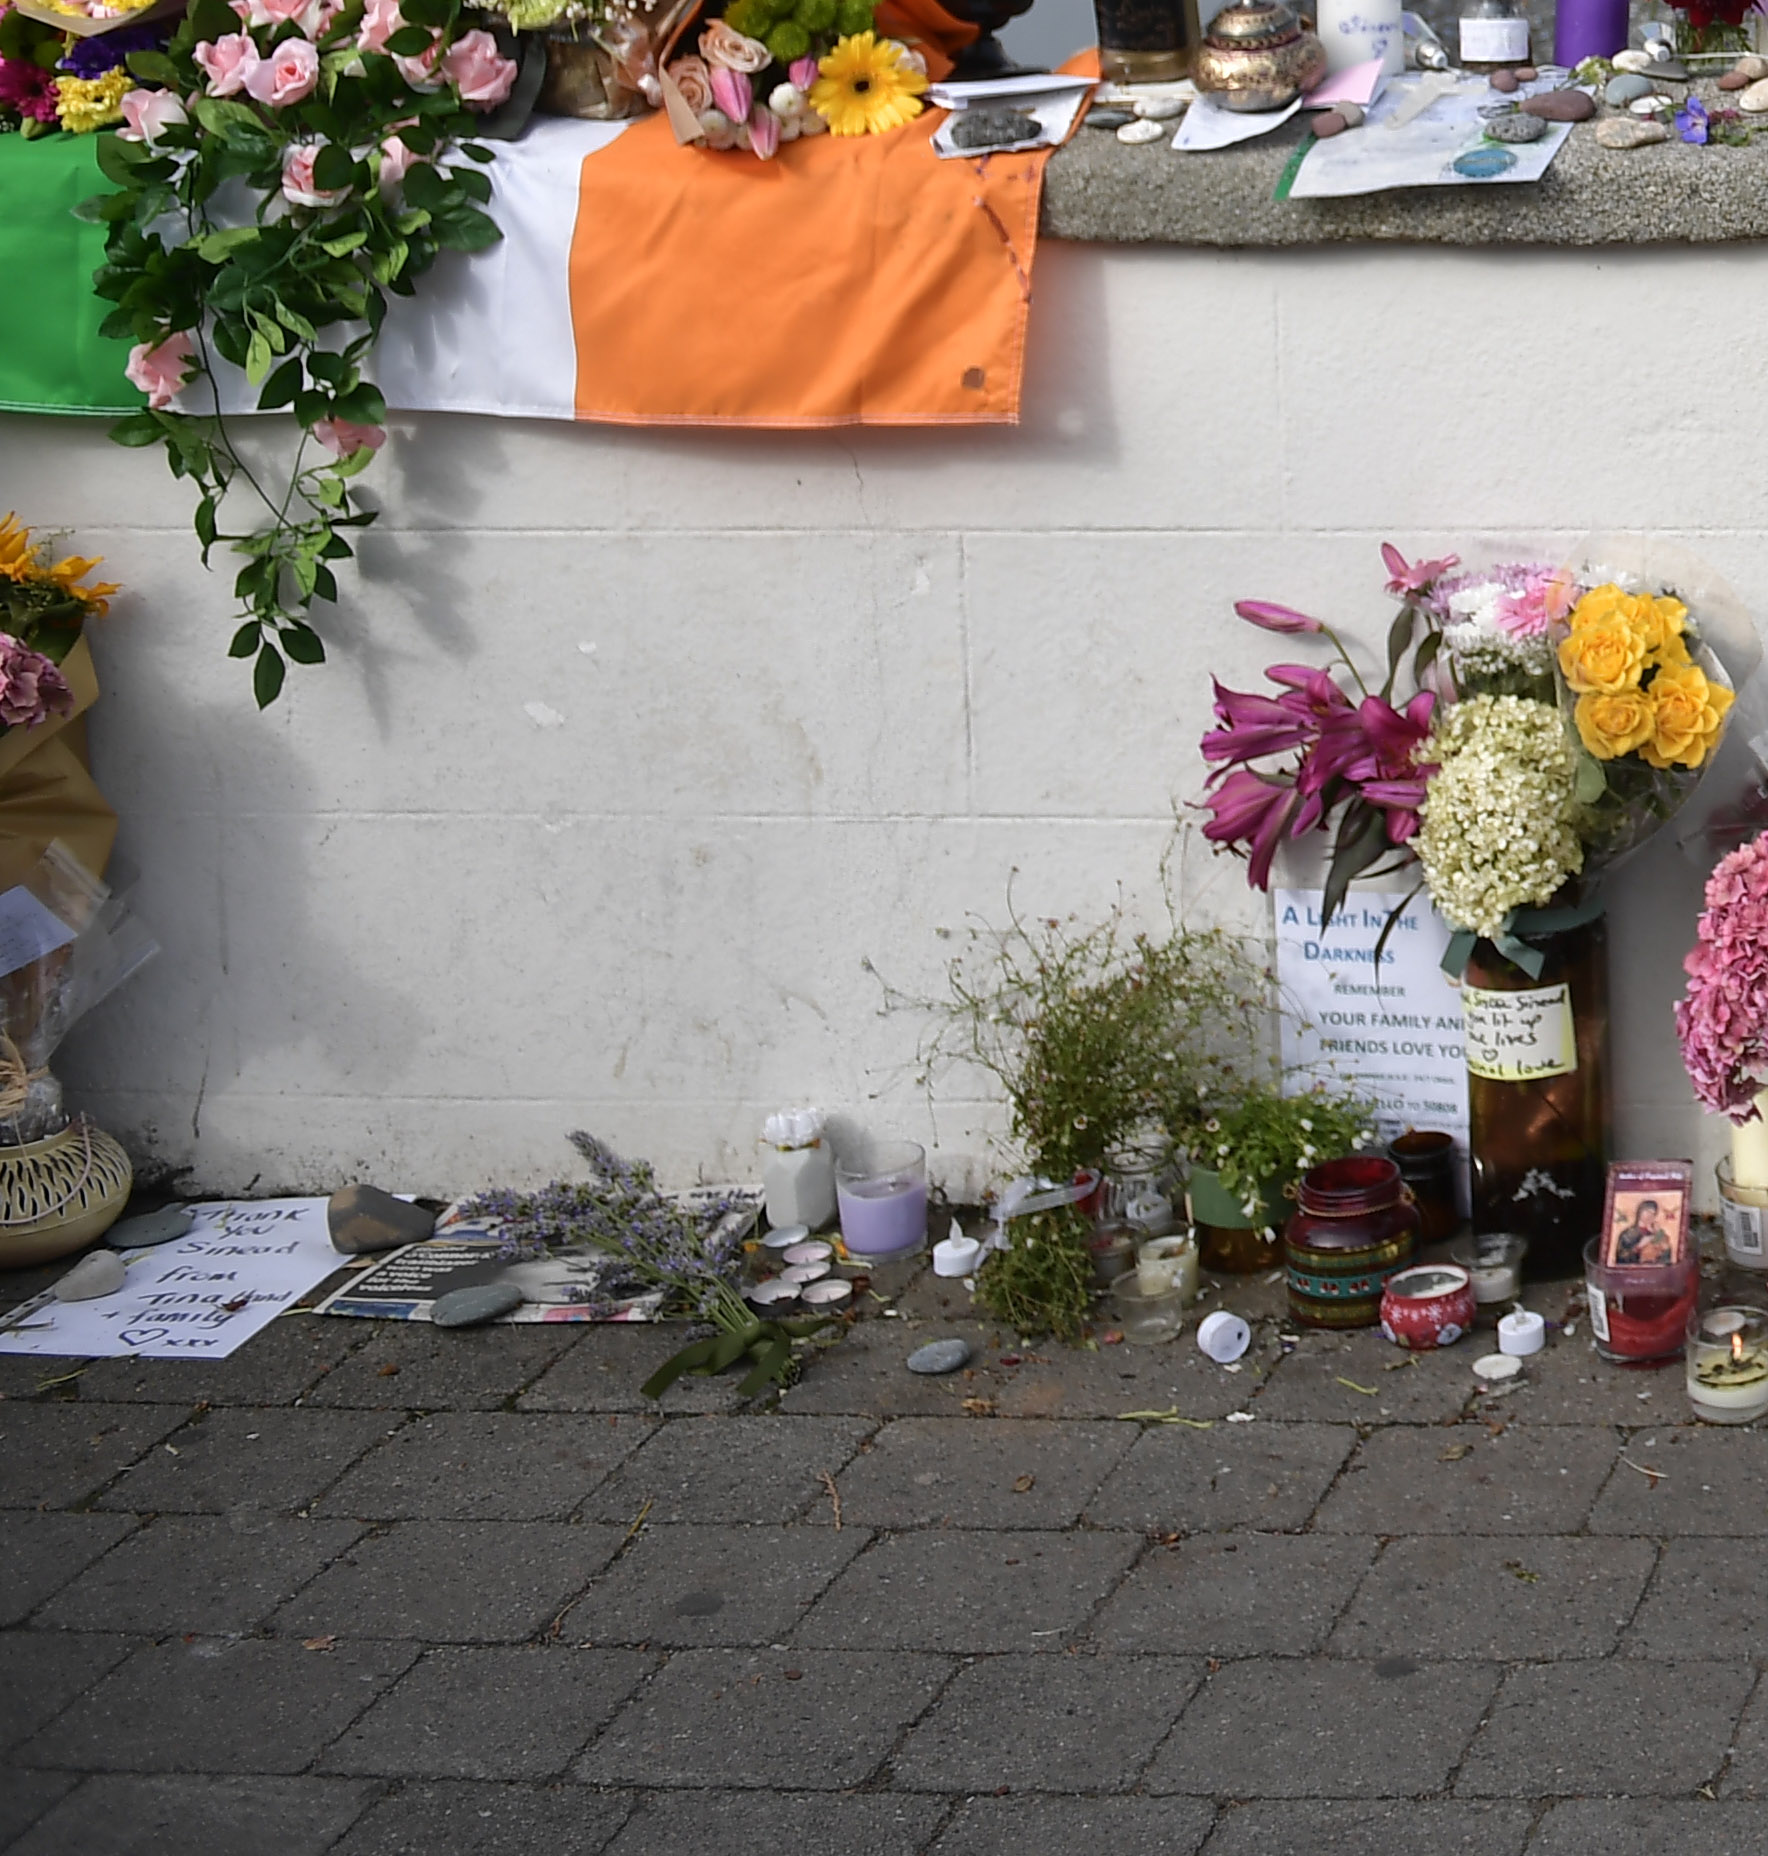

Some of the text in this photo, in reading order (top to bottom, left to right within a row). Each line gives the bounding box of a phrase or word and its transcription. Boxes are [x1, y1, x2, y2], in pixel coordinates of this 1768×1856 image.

[1282, 906, 1299, 926] A
[1303, 941, 1395, 964] DARKNES
[1335, 984, 1406, 997] REMEMBER
[1318, 1012, 1465, 1031] YOUR FAMILY AN
[1319, 1039, 1388, 1055] FRIENDS
[1393, 1042, 1433, 1056] LOVE
[1494, 1031, 1537, 1046] lives
[1516, 1058, 1565, 1075] love
[155, 1265, 238, 1284] from
[137, 1292, 223, 1306] Tina
[126, 1308, 236, 1329] family
